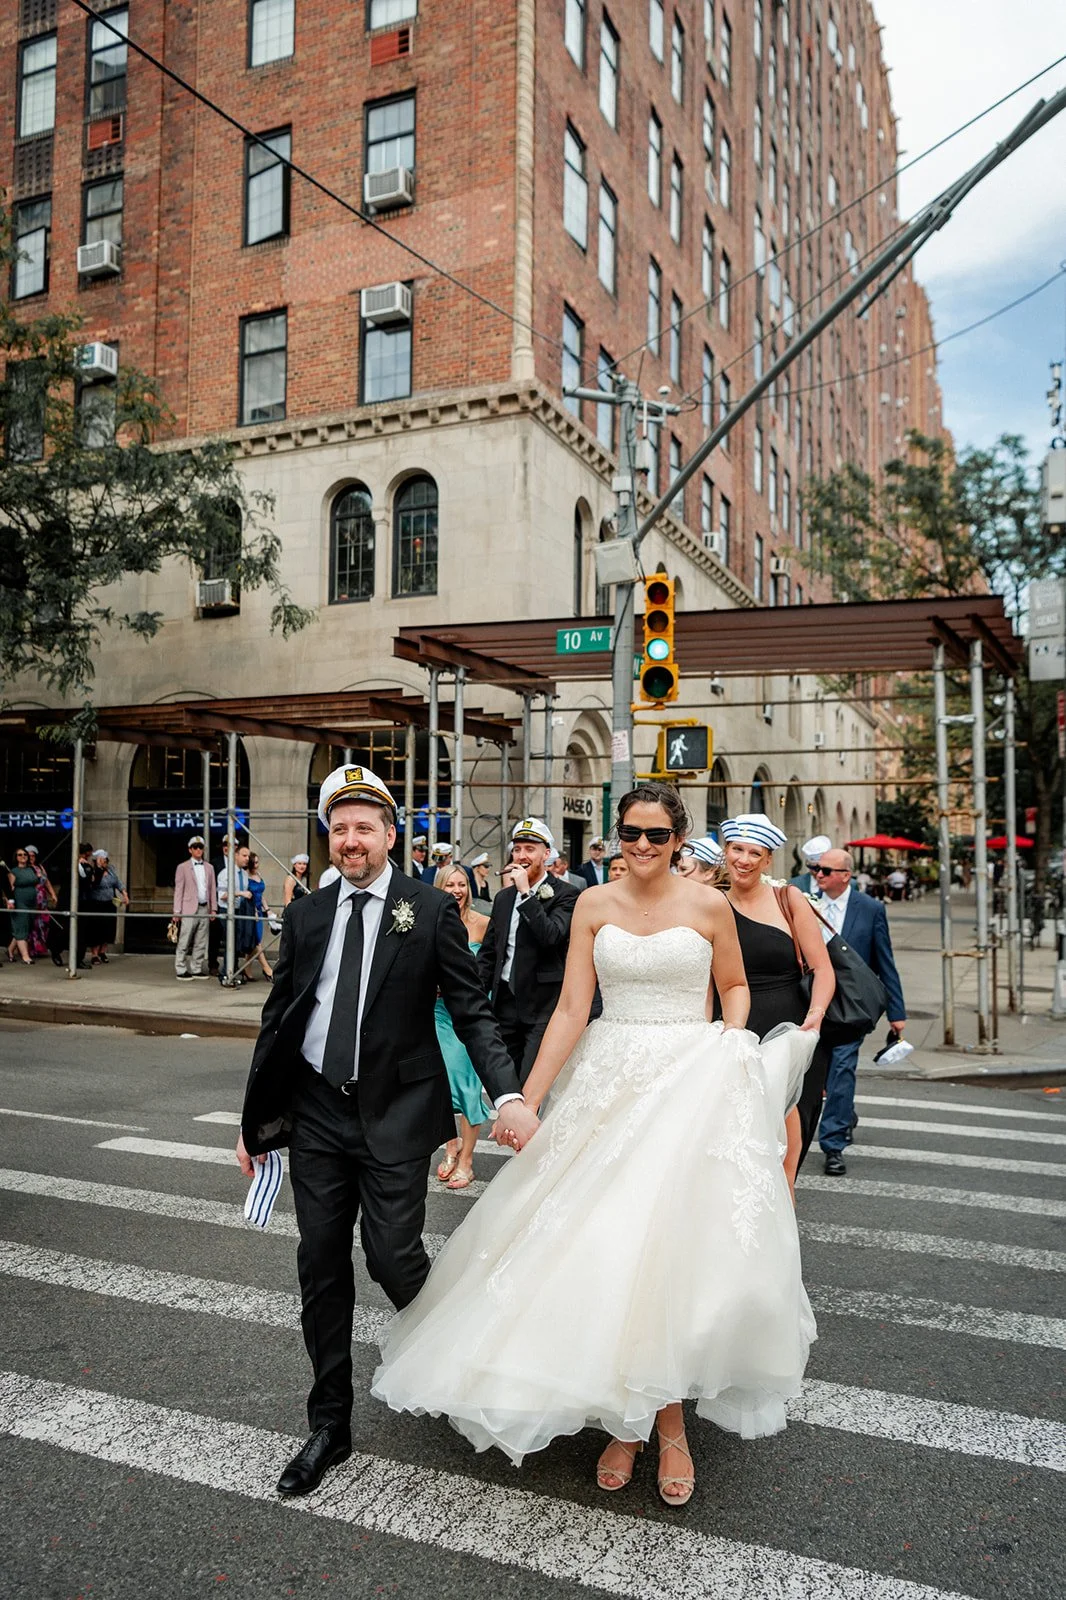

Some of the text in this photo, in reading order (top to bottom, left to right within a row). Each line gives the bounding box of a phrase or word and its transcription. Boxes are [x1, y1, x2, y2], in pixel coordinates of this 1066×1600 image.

[563, 630, 603, 650] 10 Av
[563, 796, 585, 814] HASE
